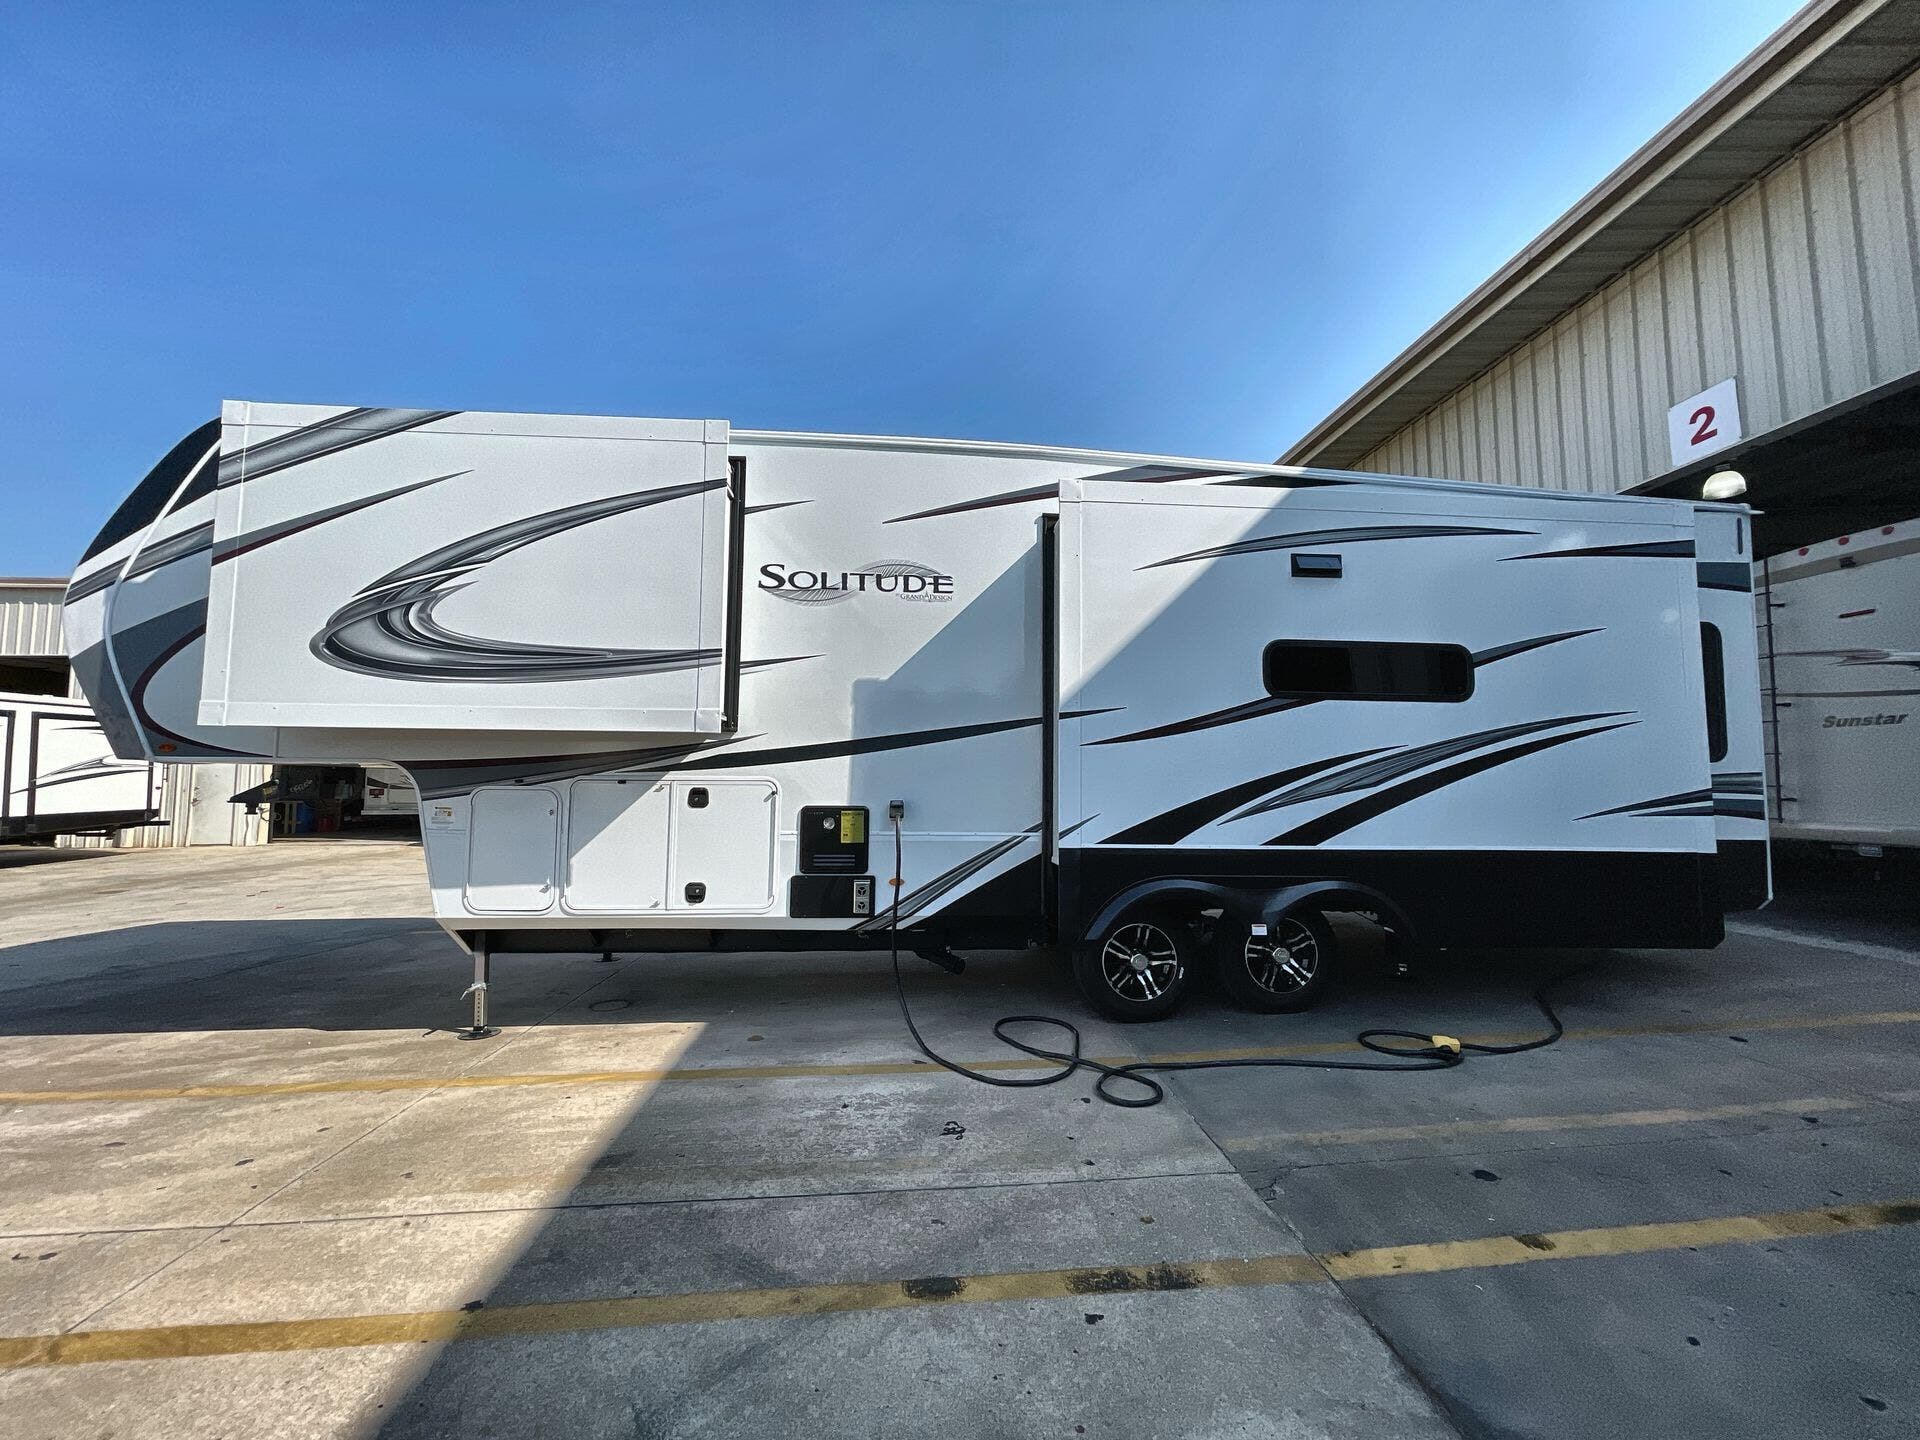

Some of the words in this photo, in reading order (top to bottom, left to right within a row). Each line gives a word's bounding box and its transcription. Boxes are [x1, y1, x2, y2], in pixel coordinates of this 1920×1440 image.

[1689, 406, 1718, 446] 2
[758, 564, 954, 593] SOLITUDE
[1822, 713, 1909, 728] Sunstar
